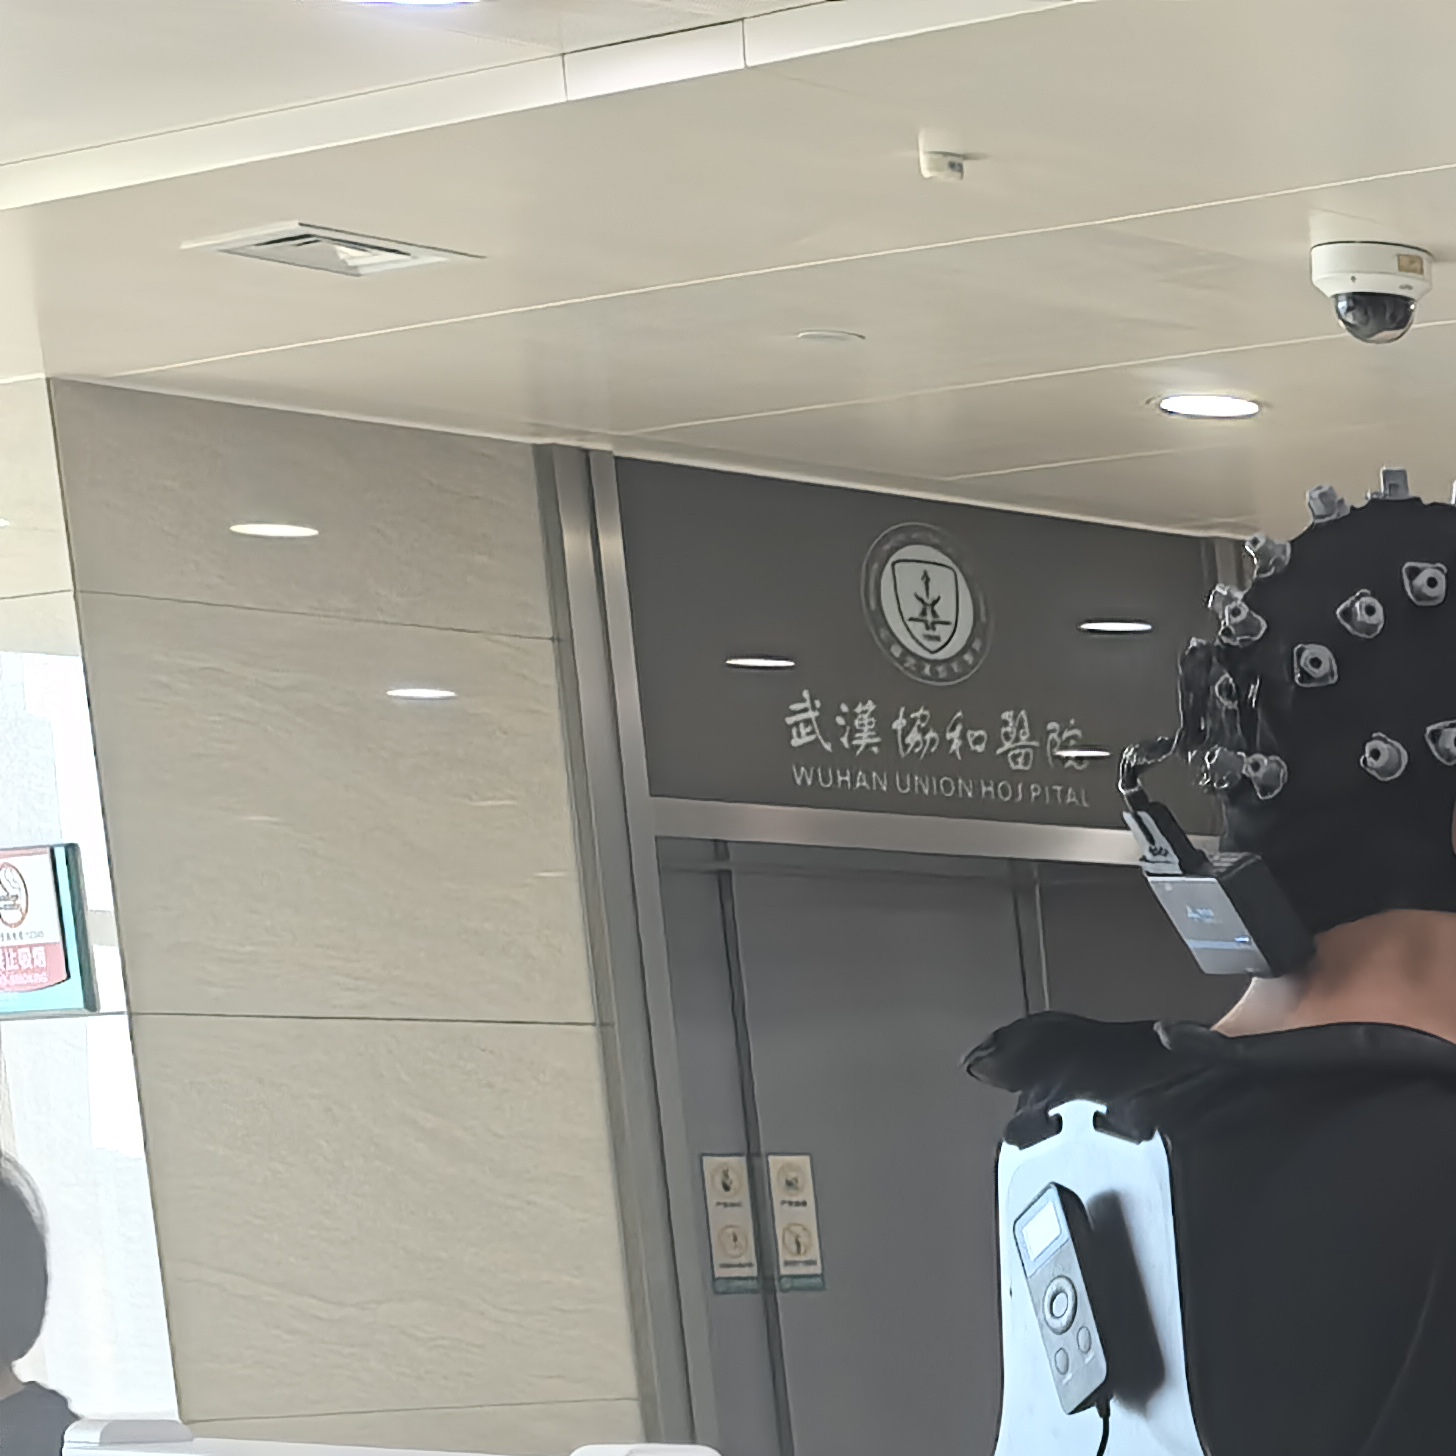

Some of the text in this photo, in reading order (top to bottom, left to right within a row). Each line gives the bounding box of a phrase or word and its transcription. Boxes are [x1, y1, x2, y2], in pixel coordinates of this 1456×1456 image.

[792, 765, 1090, 807] WUHAN UNION HOSPITAL
